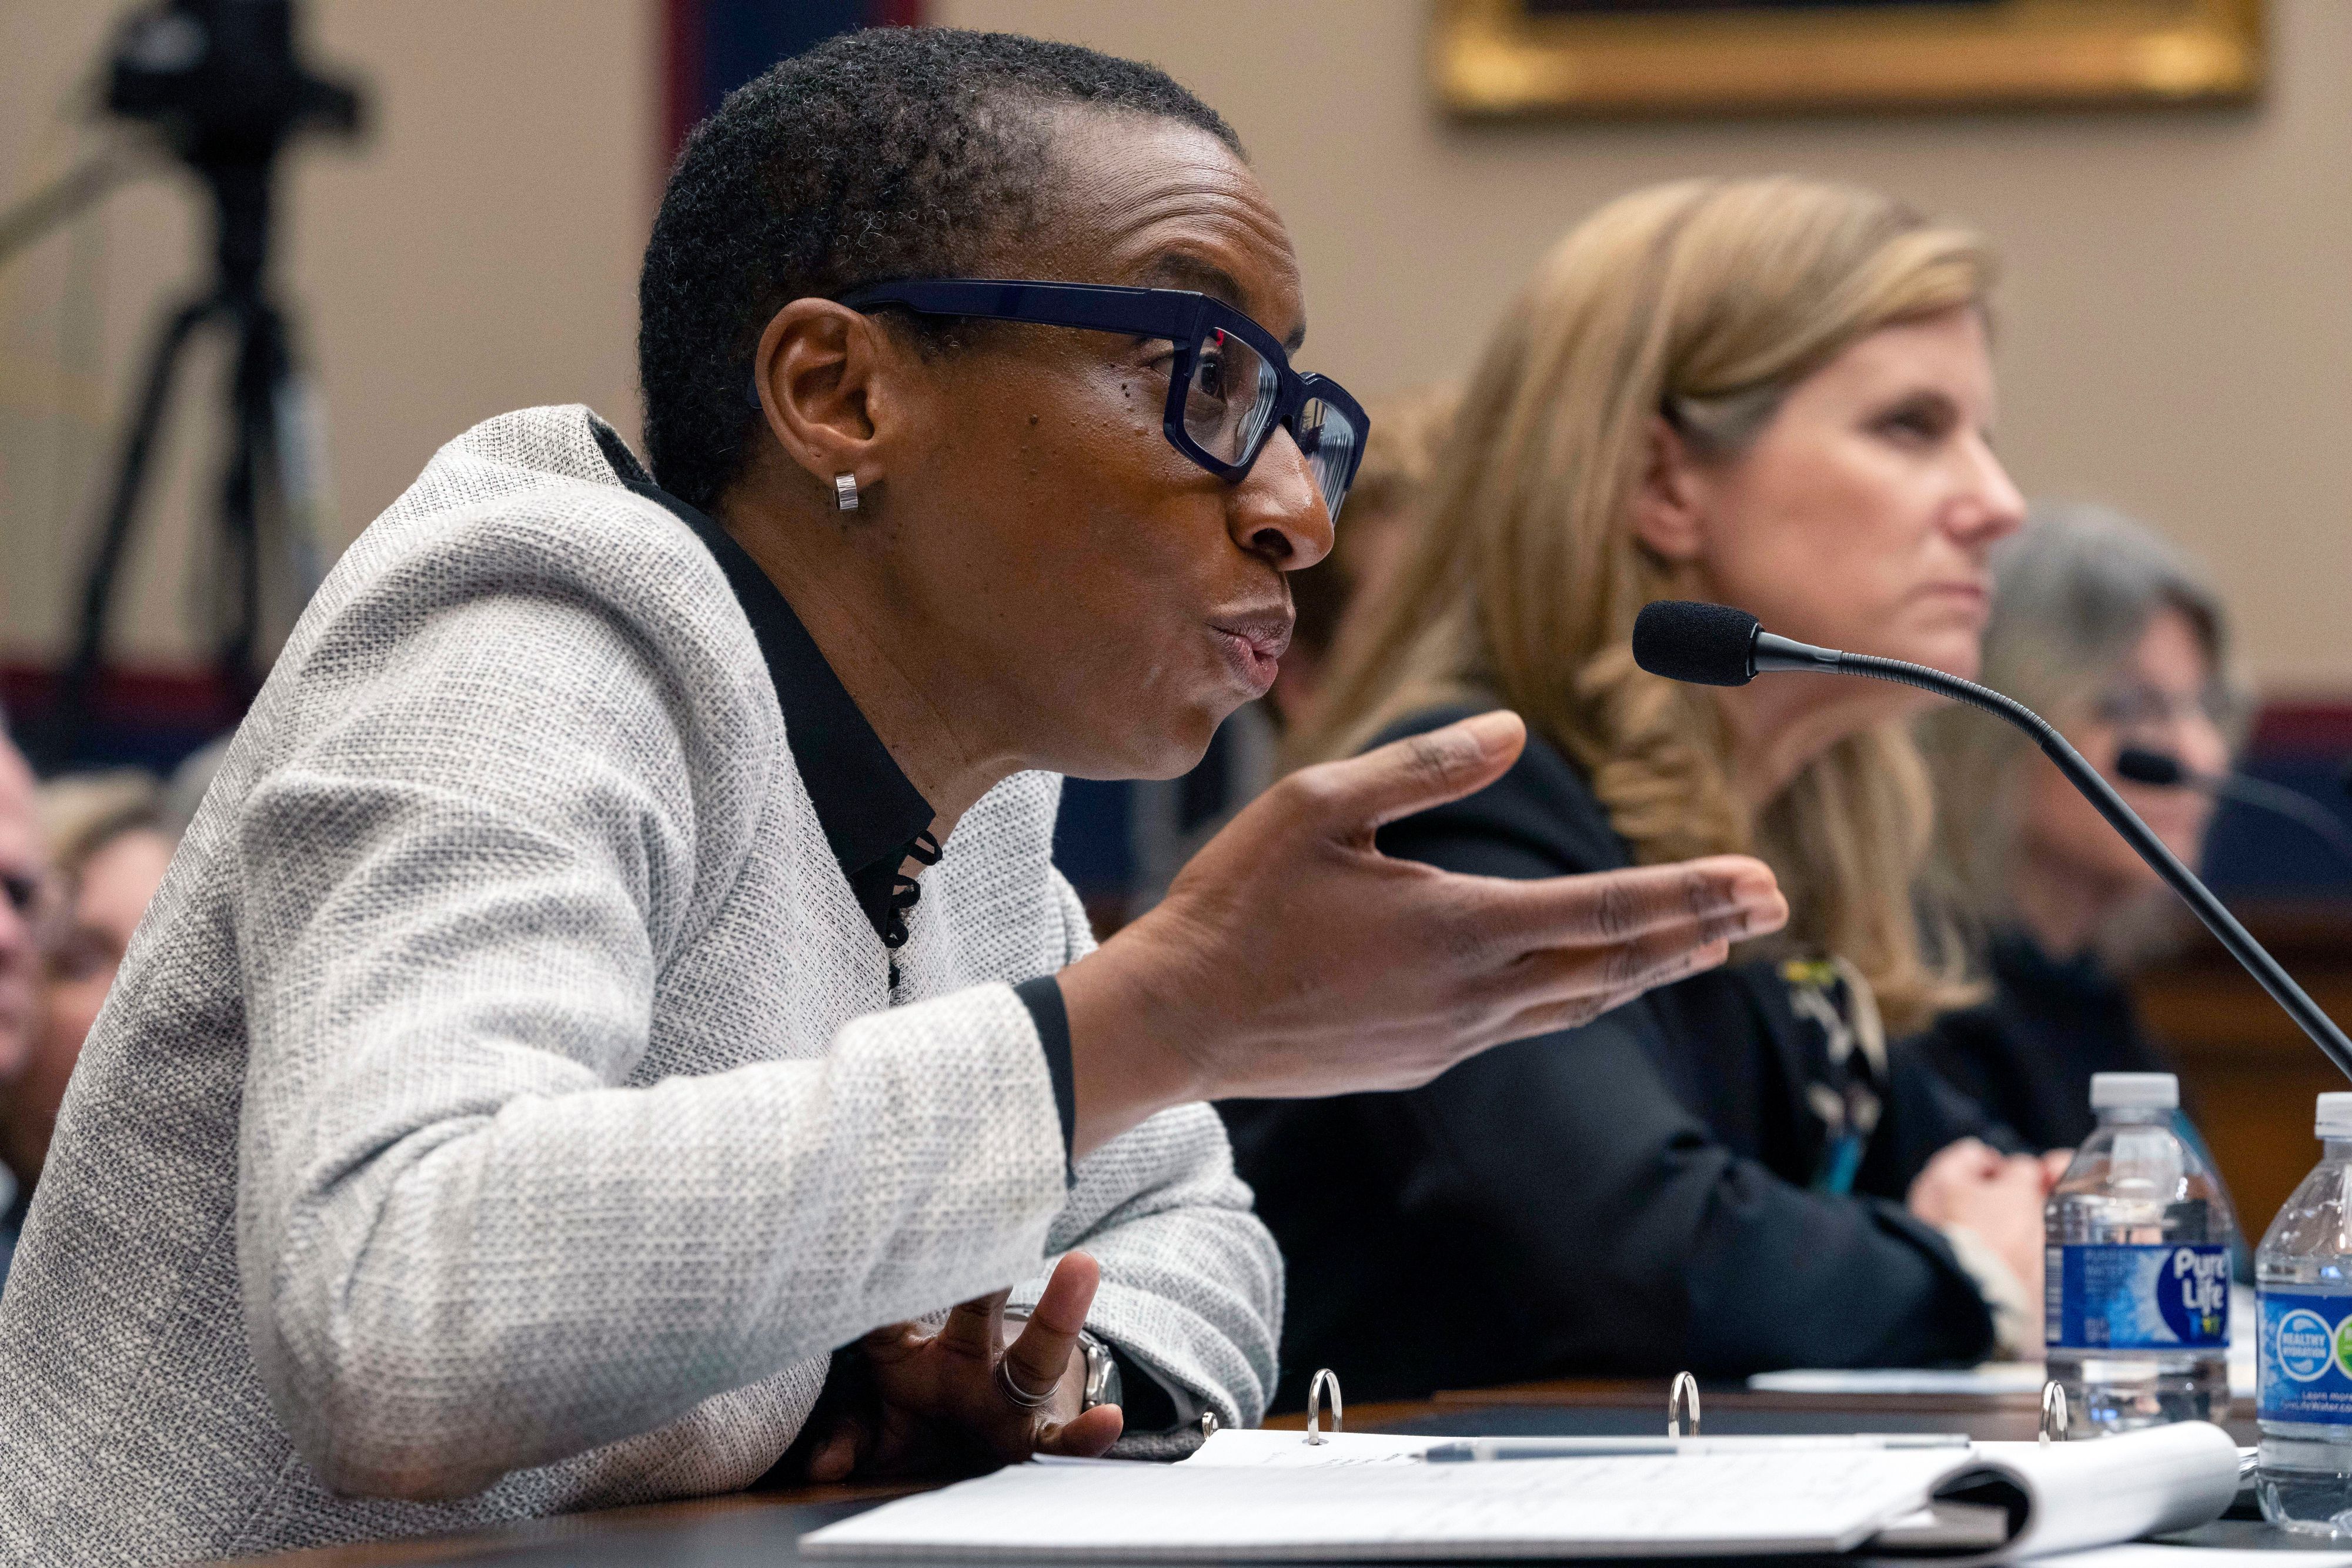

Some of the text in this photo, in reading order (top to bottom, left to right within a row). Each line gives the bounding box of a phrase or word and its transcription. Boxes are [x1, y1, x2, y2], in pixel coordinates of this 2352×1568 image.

[2174, 1248, 2226, 1279] Pure
[2182, 1276, 2224, 1316] Life
[2283, 1333, 2326, 1346] HEALTHY
[2301, 1390, 2327, 1400] Learn
